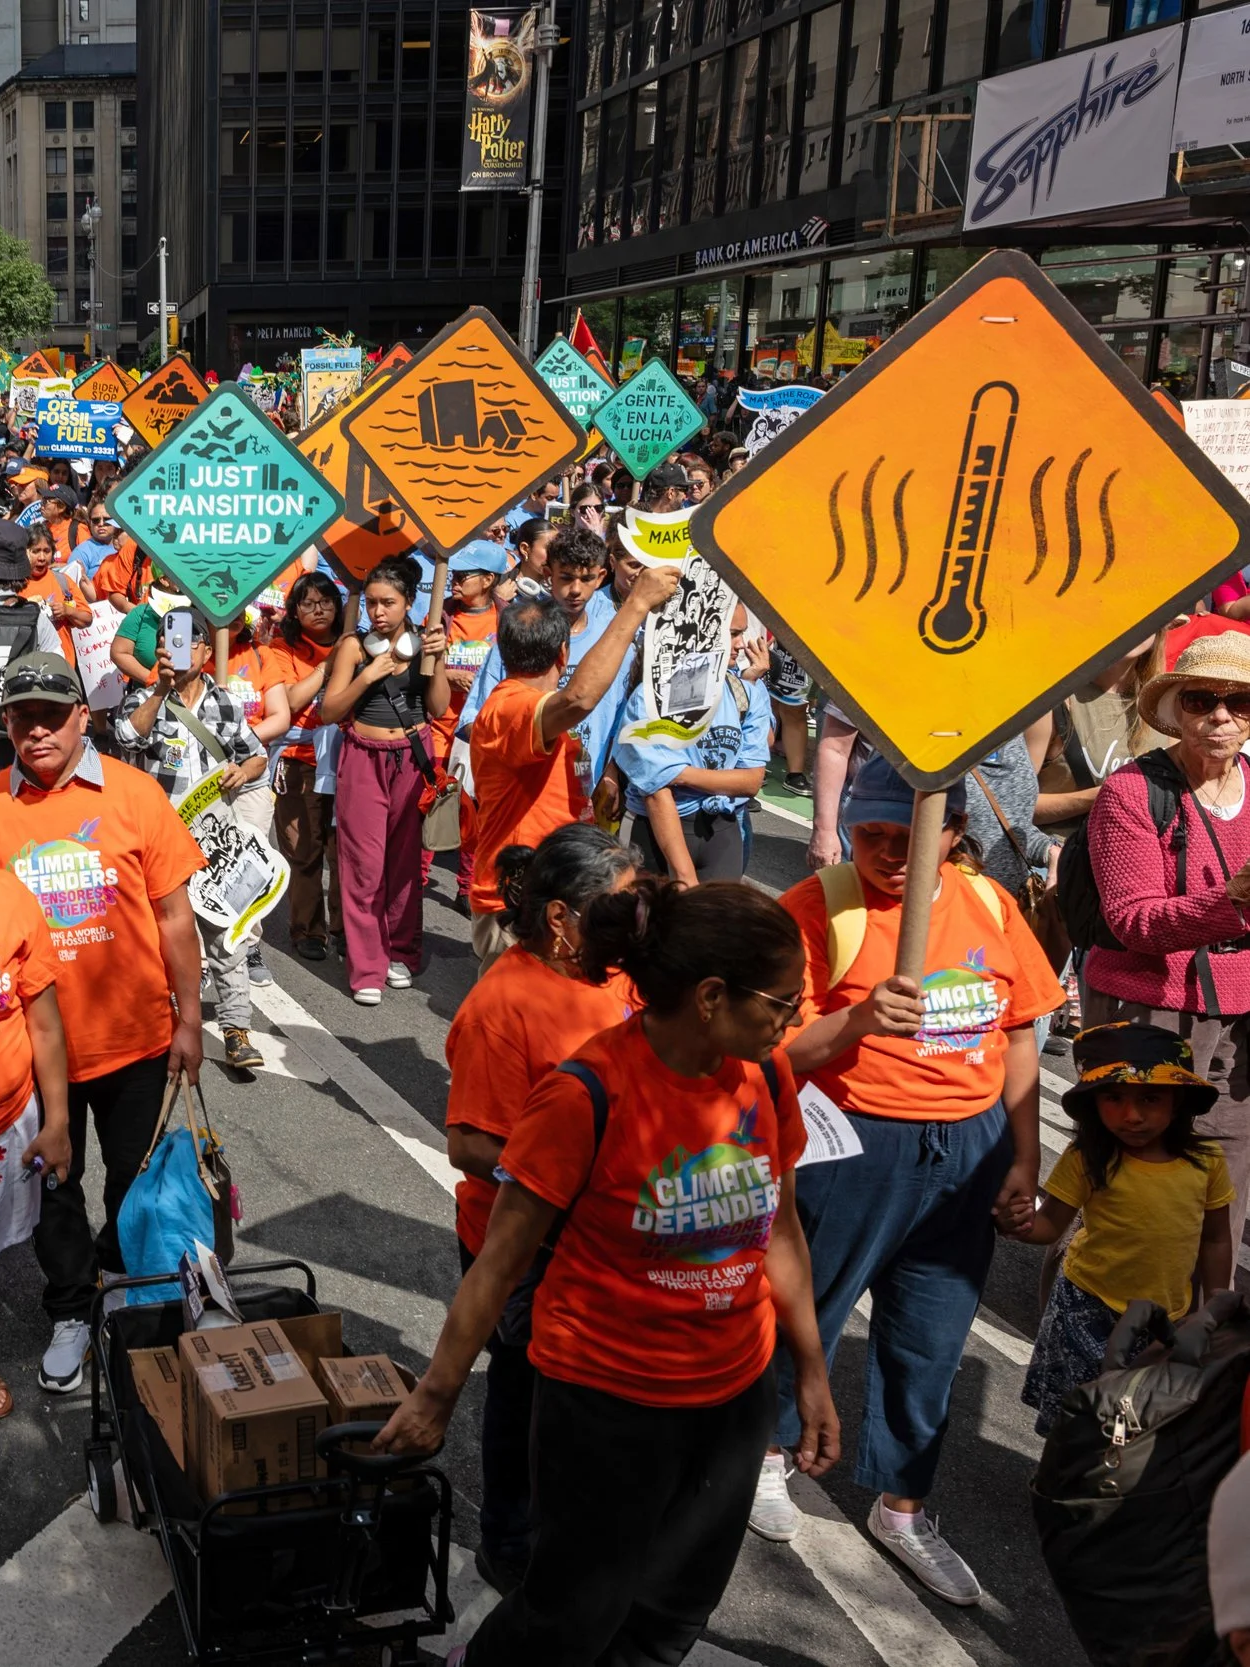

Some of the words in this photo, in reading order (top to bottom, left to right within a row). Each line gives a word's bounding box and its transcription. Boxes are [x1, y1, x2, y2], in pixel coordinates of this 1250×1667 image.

[1220, 70, 1245, 87] NORTH
[468, 111, 511, 142] Harry
[970, 52, 1175, 224] Sapphire
[481, 133, 525, 166] Potter
[695, 246, 723, 266] BANK
[726, 242, 740, 260] OF
[743, 230, 798, 255] AMERICA
[257, 328, 273, 339] PRET
[275, 328, 281, 338] A
[283, 326, 312, 338] MANGER
[305, 361, 332, 370] FOSSIL
[334, 361, 360, 369] FUELS
[91, 391, 117, 401] STOP
[92, 382, 119, 393] BIDEN
[47, 400, 79, 412] OFF
[625, 394, 676, 408] GENTE
[750, 395, 774, 404] MAKE
[777, 391, 795, 399] THE
[37, 411, 93, 428] FOSSIL
[626, 412, 647, 424] EN
[651, 412, 670, 424] LA
[57, 426, 106, 444] FUELS
[621, 428, 673, 442] LUCHA
[50, 445, 83, 453] CLIMATE
[93, 446, 115, 454] 23321
[190, 466, 258, 487] JUST
[144, 494, 304, 516] TRANSITION
[179, 523, 271, 544] AHEAD
[649, 527, 690, 545] MAKE
[179, 801, 193, 819] HE
[183, 802, 202, 825] NEW
[14, 850, 102, 878] CLIMATE
[19, 867, 119, 893] FENDERS
[37, 888, 103, 905] ENSORES
[56, 900, 107, 918] TIERRA
[62, 936, 90, 946] FOSSIL
[91, 931, 115, 943] FUELS
[75, 926, 107, 937] WORLD
[927, 979, 998, 1010] IMATE
[655, 1154, 772, 1207] CLIMATE
[647, 1270, 709, 1283] BUILDING
[712, 1270, 721, 1280] A
